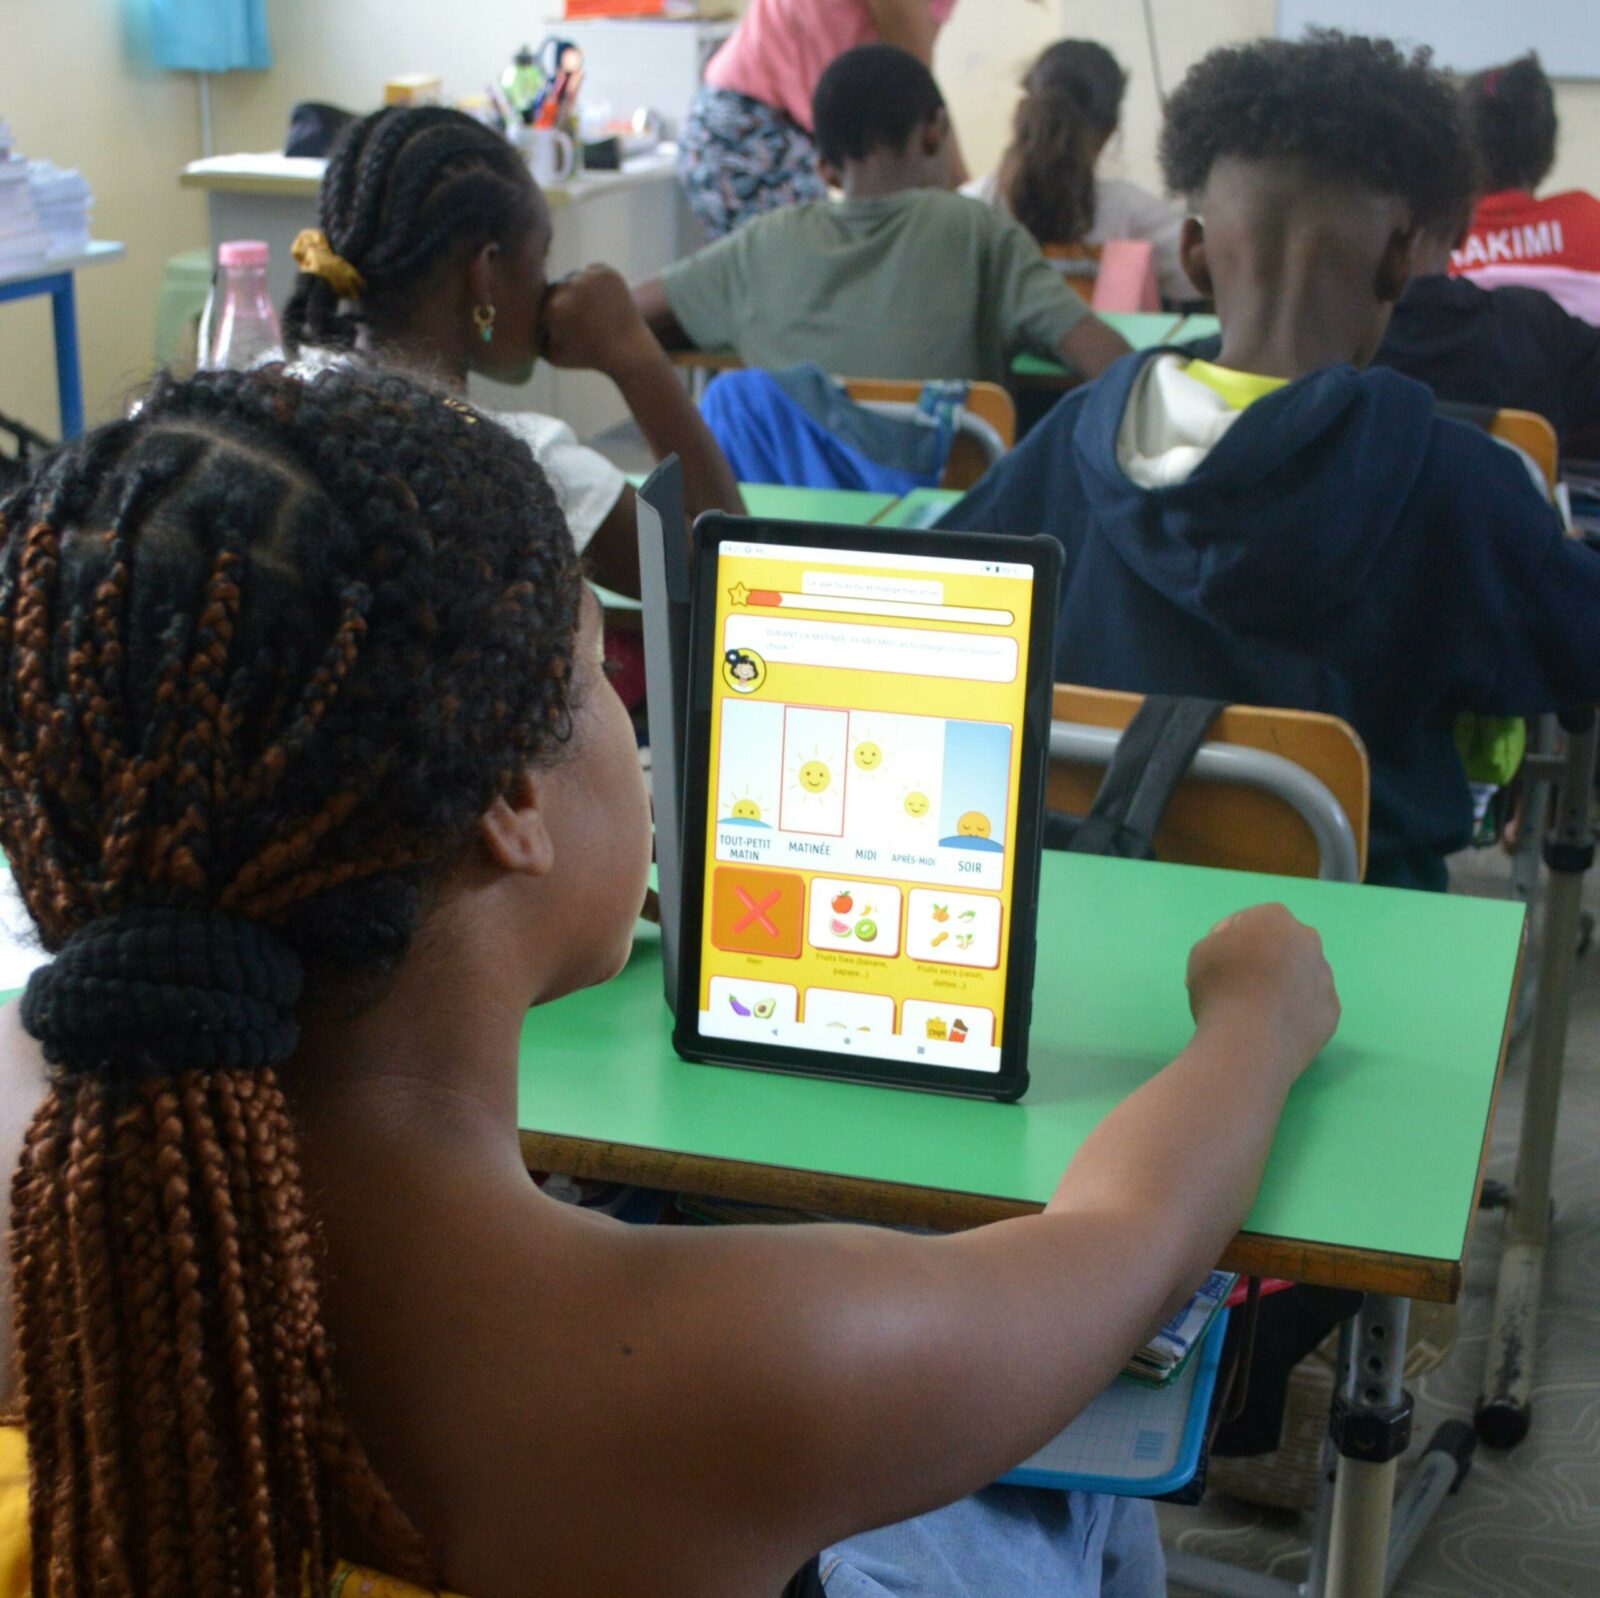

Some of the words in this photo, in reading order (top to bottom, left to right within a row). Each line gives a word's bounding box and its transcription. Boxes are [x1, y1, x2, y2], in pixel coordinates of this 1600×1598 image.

[720, 835, 771, 849] TOUT-PETIT
[789, 841, 831, 855] MATINÉE
[730, 849, 759, 860] MATIN
[855, 849, 877, 861] MIDI
[891, 853, 936, 867] APRÈS-MIDI
[958, 861, 982, 873] SOIR
